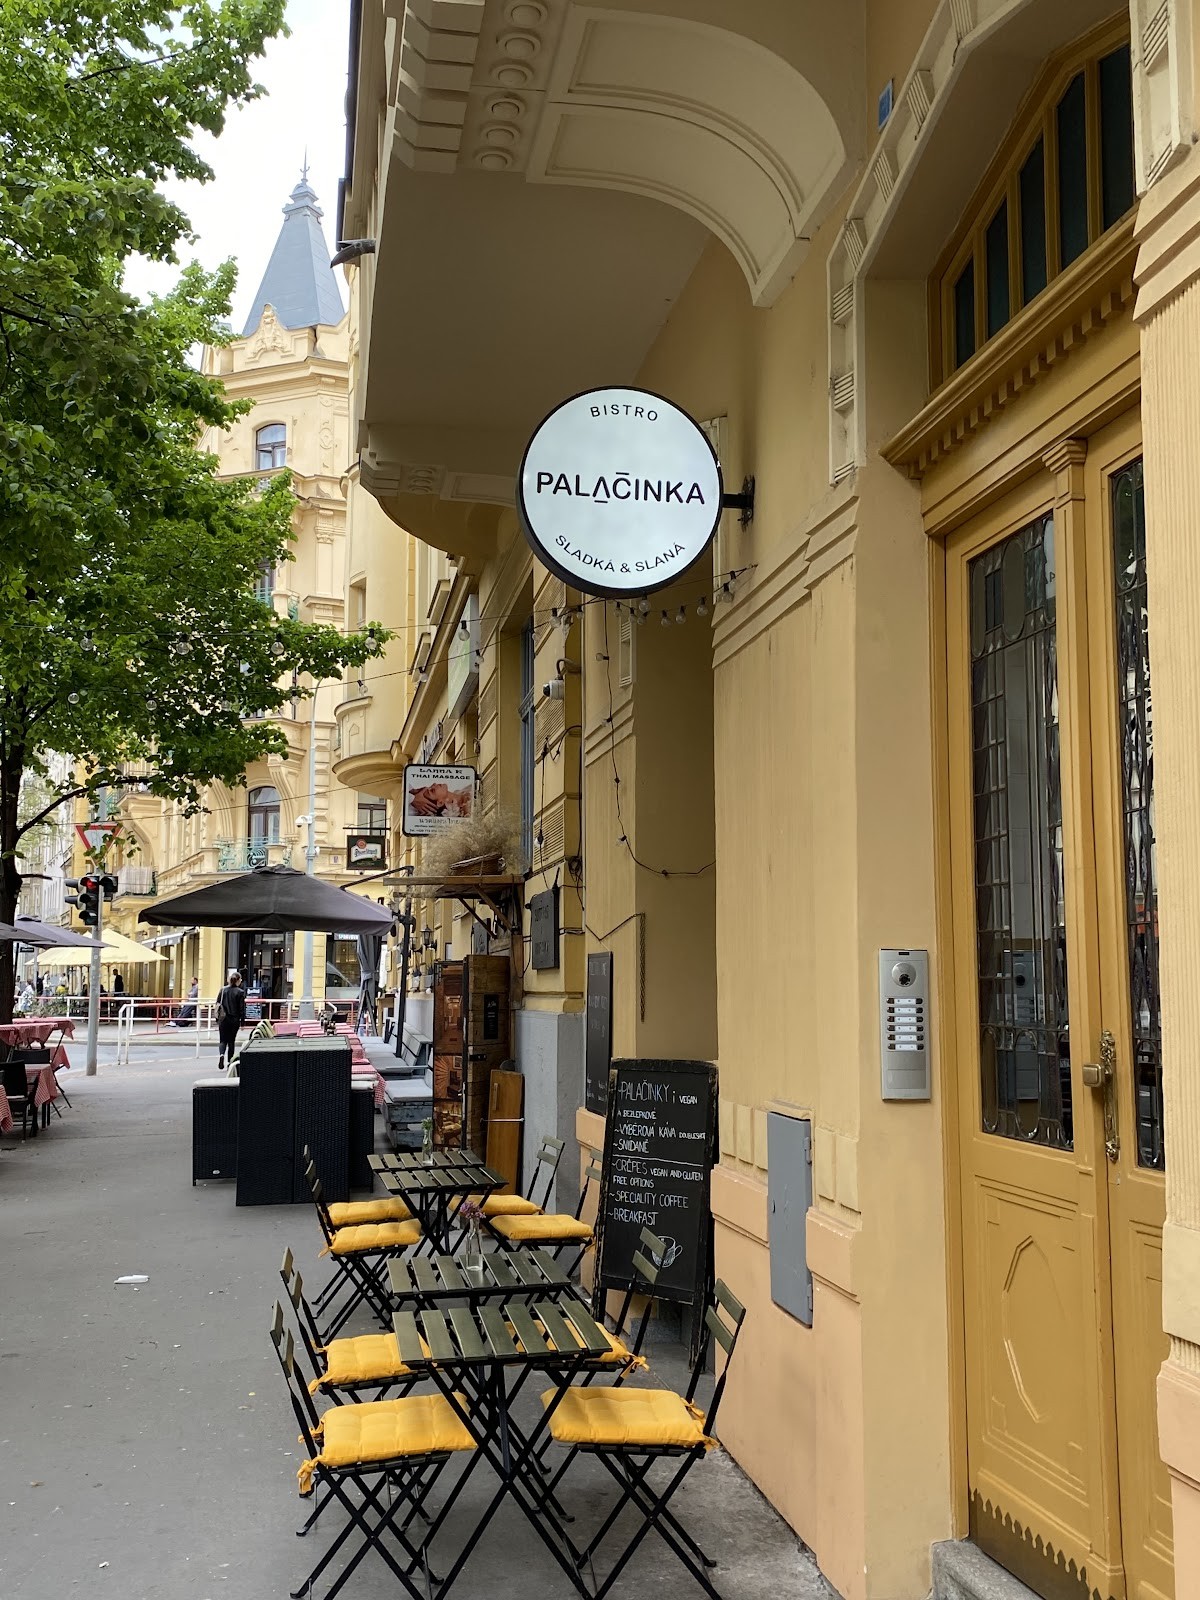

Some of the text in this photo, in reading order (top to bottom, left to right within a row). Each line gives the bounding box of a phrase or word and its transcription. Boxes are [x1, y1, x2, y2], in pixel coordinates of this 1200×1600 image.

[590, 404, 658, 422] BISTRO
[555, 534, 686, 573] SLADKÁ & SLANÁ
[620, 1079, 670, 1102] PALAČINKY
[679, 1095, 697, 1104] VEGAN
[658, 1121, 676, 1138] KÁVA
[679, 1132, 706, 1140] DOUBLESHOT
[615, 1158, 647, 1174] CRÊPES
[650, 1168, 668, 1177] VEGAN
[683, 1171, 703, 1181] GLUTEN
[613, 1175, 654, 1188] FREE OPTIONS
[615, 1191, 689, 1208] SPECIALITY COFFEE
[614, 1207, 658, 1225] BREAKFAST
